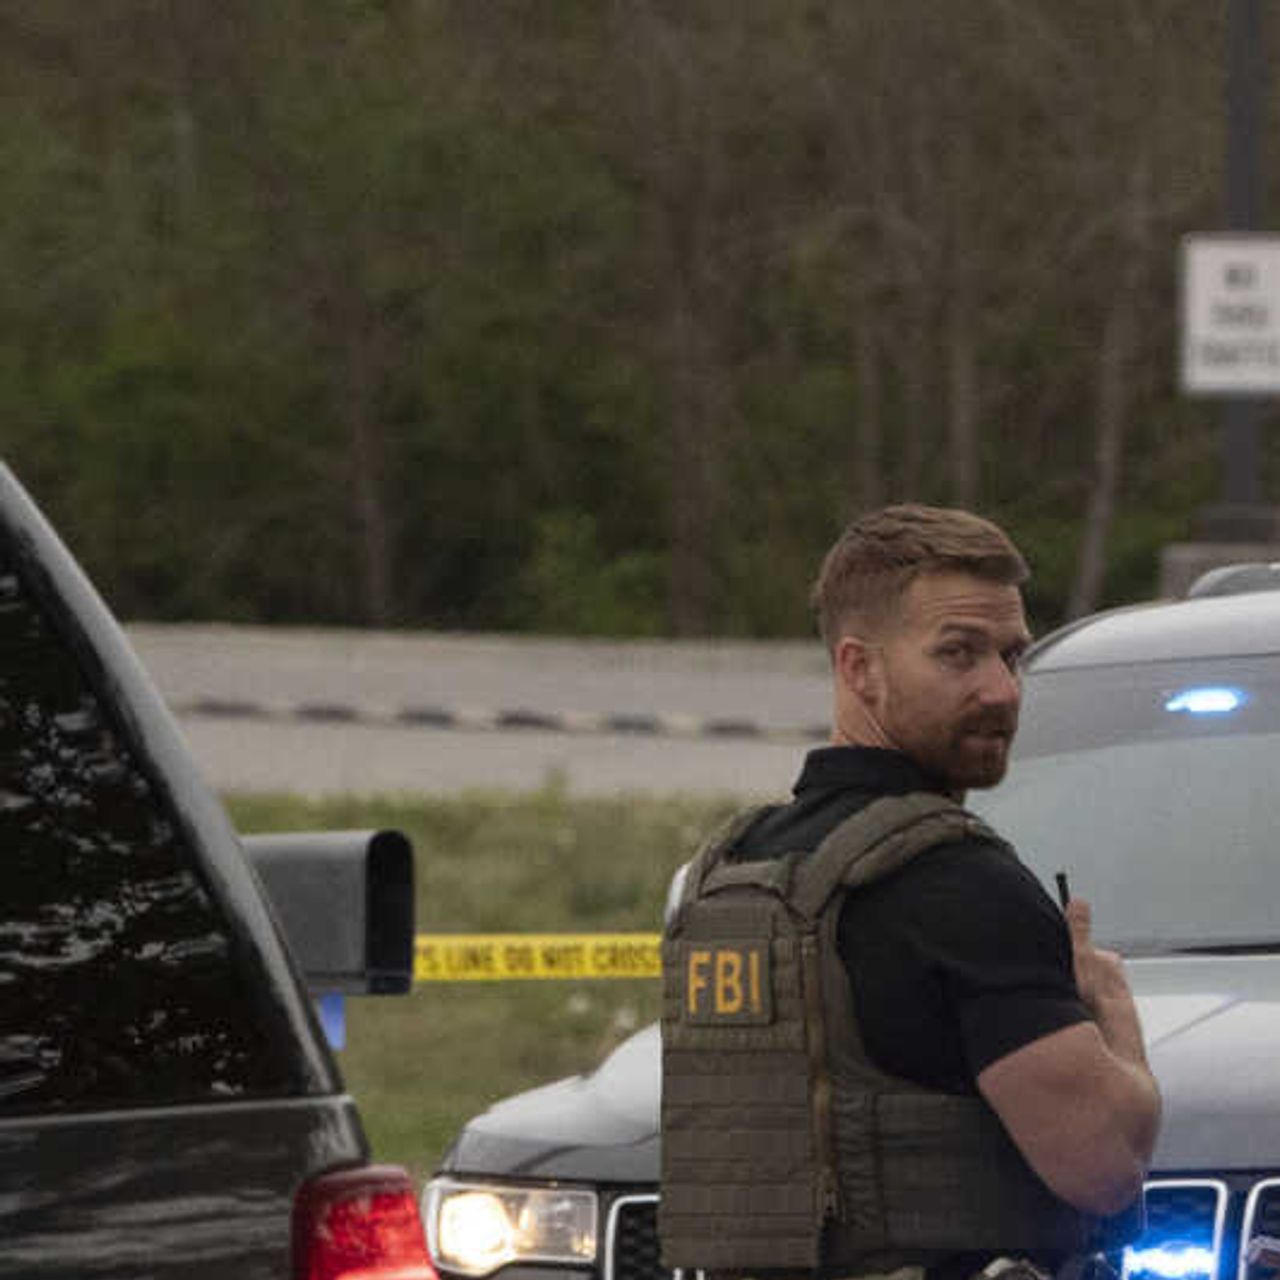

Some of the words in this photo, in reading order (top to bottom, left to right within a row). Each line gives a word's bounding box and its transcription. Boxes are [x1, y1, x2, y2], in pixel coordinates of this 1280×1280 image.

[445, 943, 495, 973] LINE
[504, 943, 534, 973] DO
[541, 942, 586, 972] NOT
[688, 950, 763, 1016] FBI
